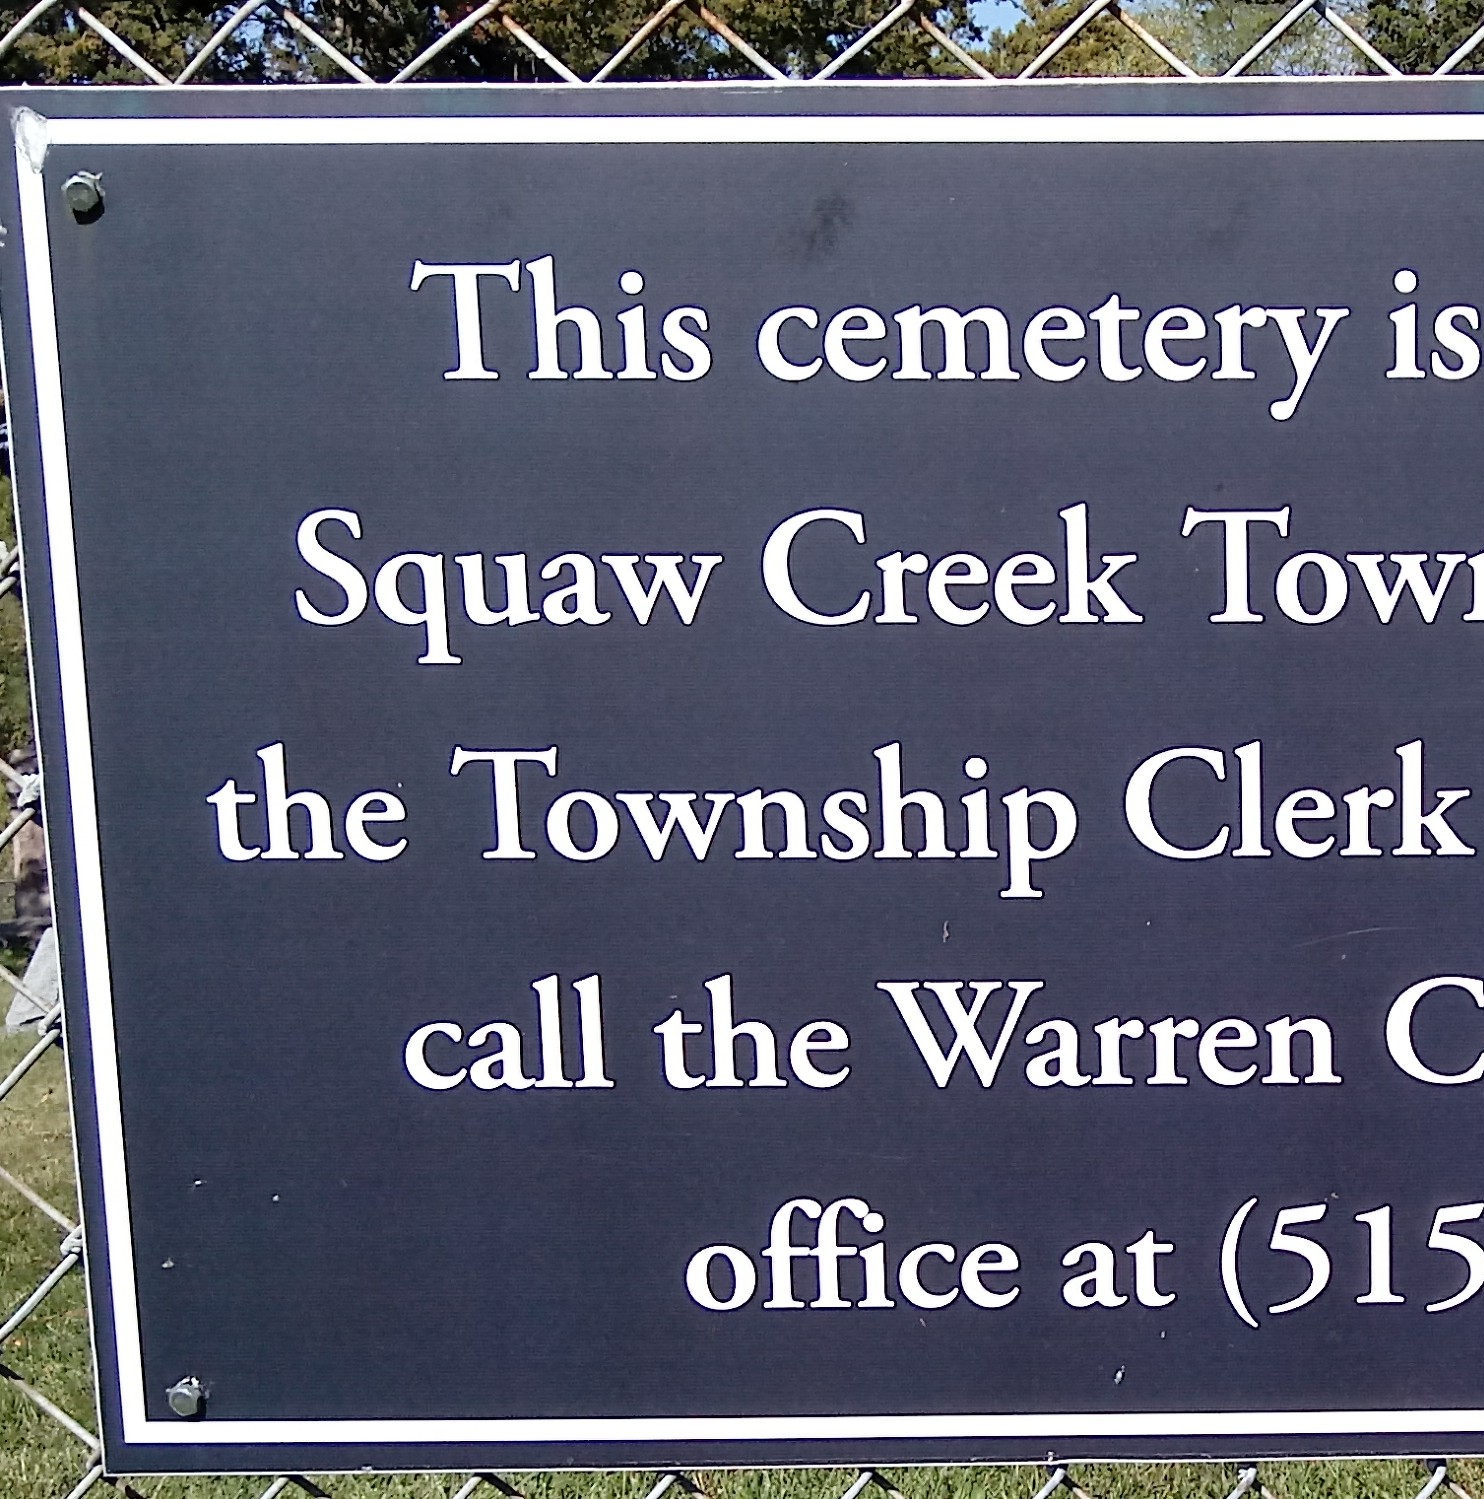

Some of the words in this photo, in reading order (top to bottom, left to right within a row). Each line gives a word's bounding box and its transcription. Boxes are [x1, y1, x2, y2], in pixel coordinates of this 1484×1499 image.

[411, 256, 710, 380] This
[759, 295, 1349, 420] cemetery
[1387, 271, 1480, 379] is
[296, 510, 722, 663] Squaw
[763, 504, 1143, 625] Creek
[207, 743, 407, 860] the
[451, 743, 1076, 897] Township
[1126, 740, 1475, 858] Clerk
[406, 975, 613, 1089] call
[654, 975, 849, 1088] the
[877, 982, 1341, 1087] Warren
[687, 1199, 1019, 1310] office
[1063, 1231, 1175, 1307] at
